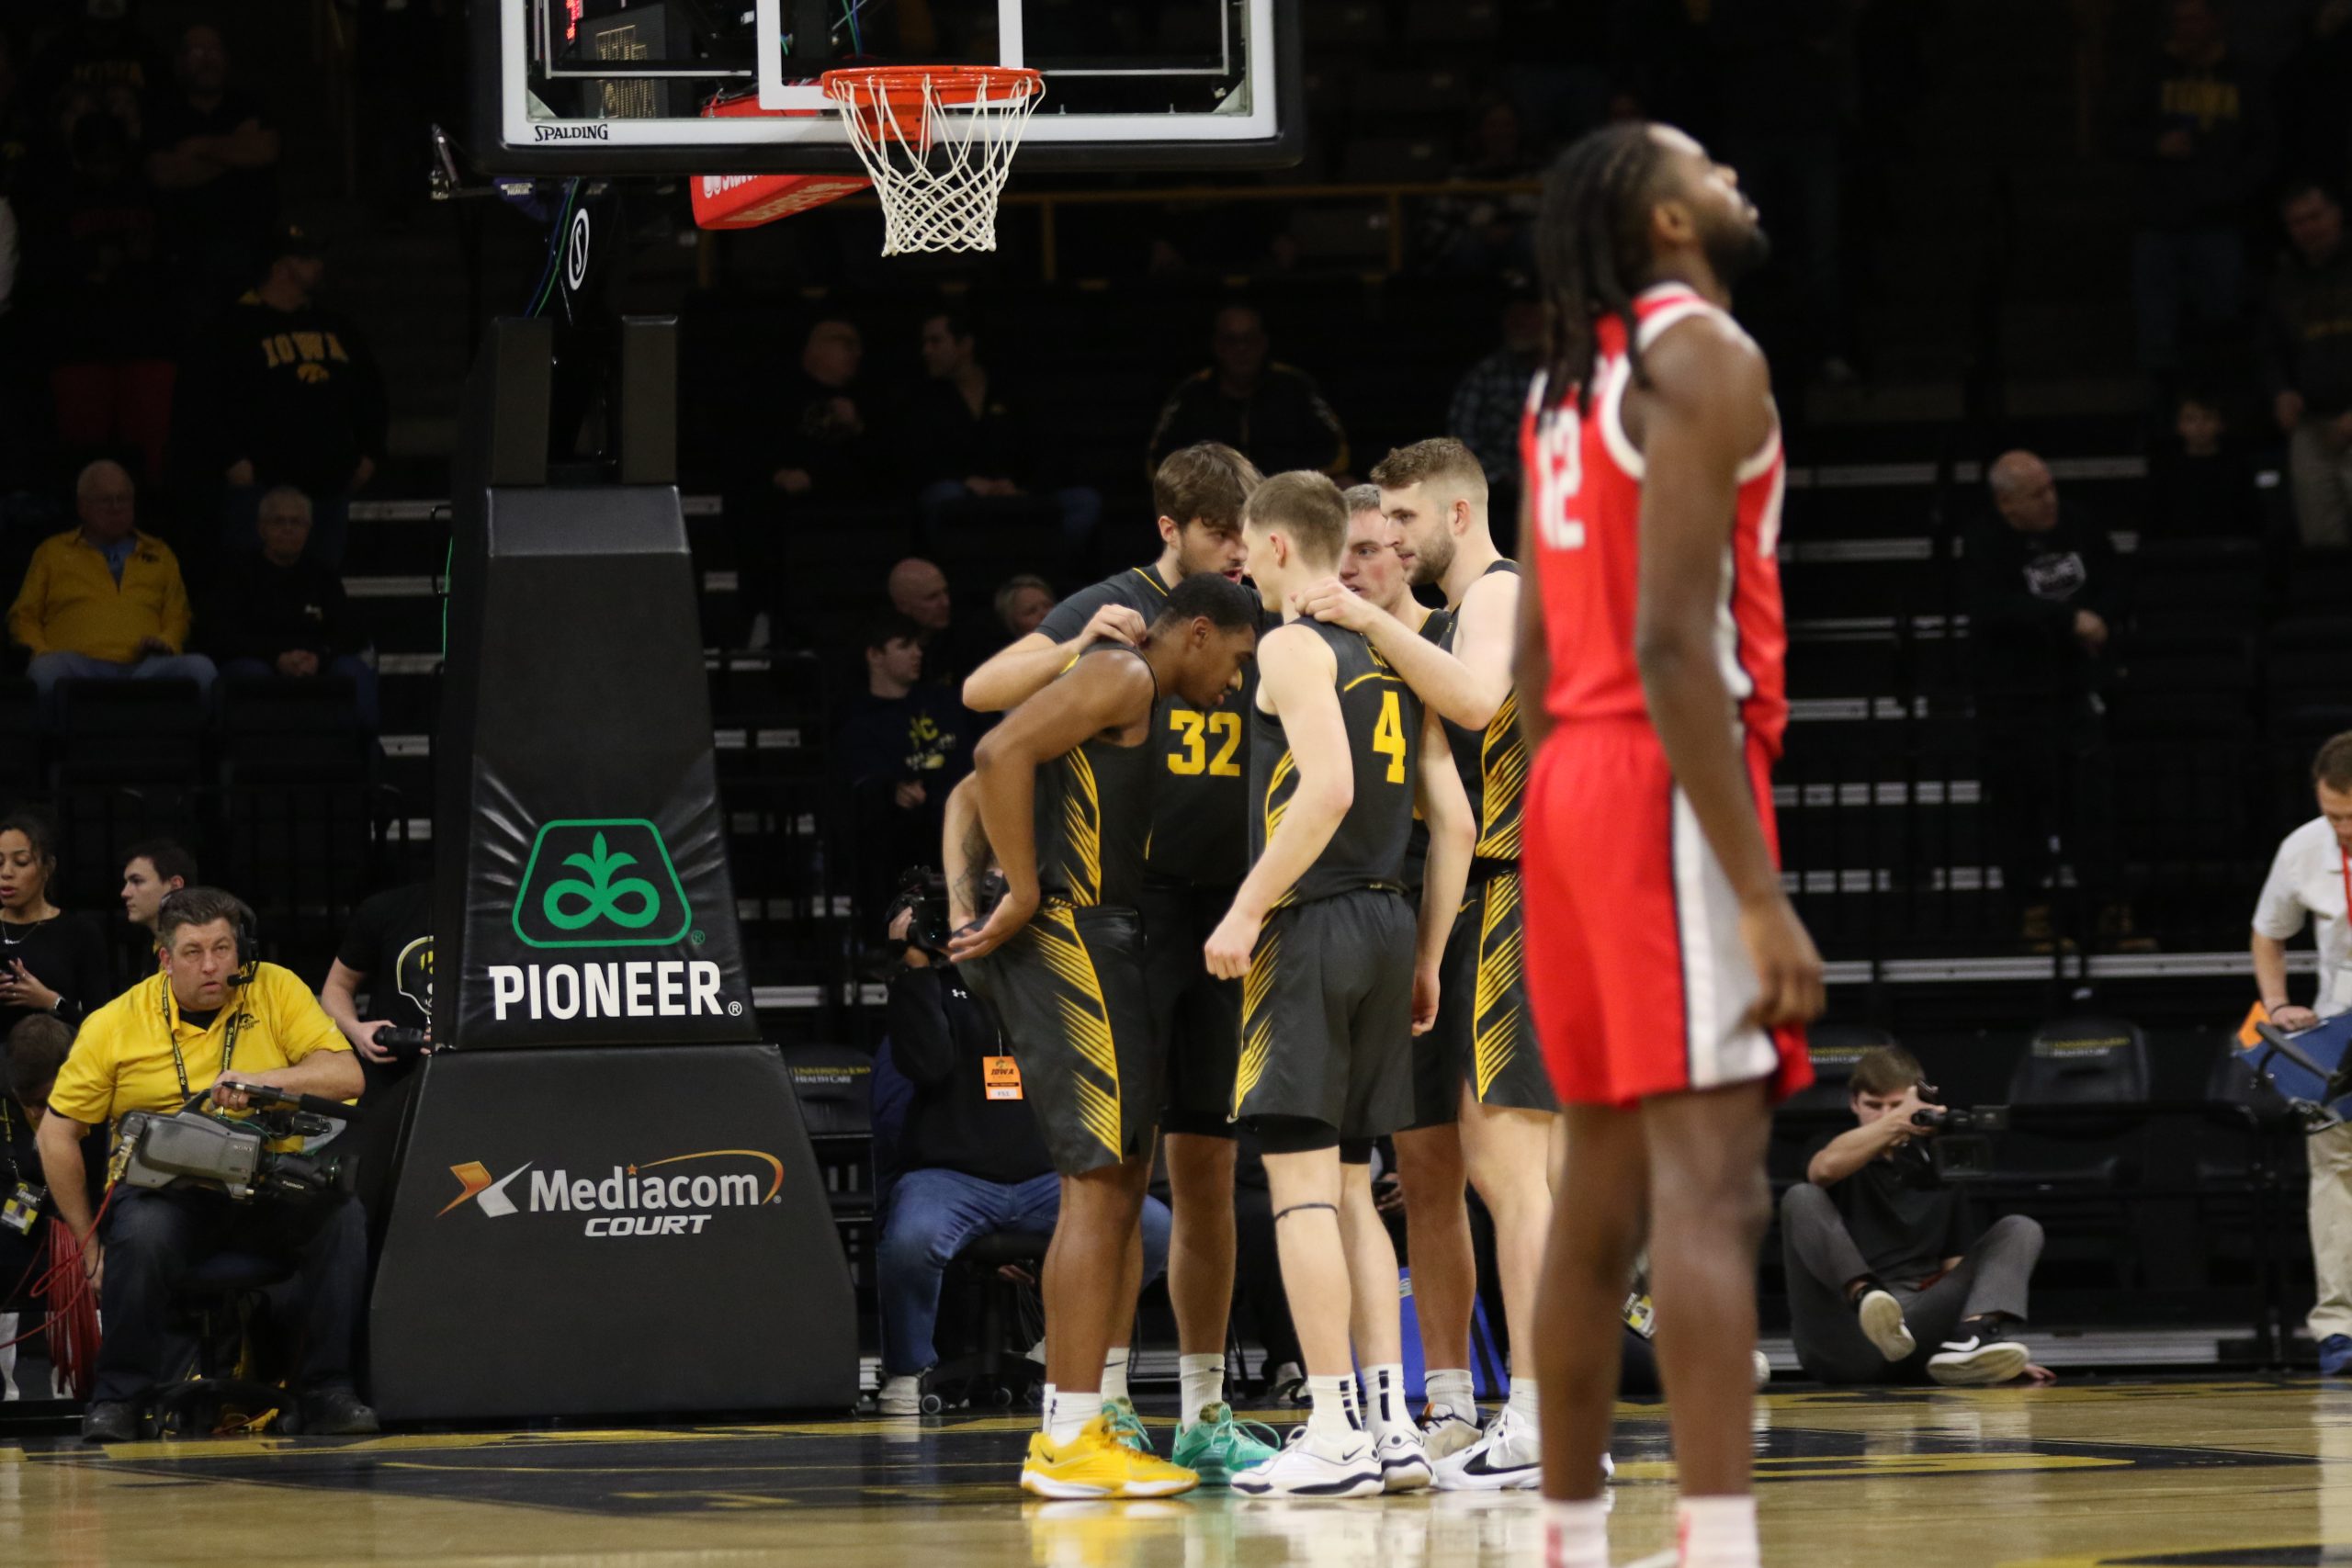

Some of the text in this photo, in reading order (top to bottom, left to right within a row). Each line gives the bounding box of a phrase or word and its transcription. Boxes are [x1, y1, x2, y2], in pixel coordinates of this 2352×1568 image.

[535, 124, 608, 141] SPALDING
[261, 331, 349, 367] IOWA
[1168, 708, 1241, 777] 32
[1373, 690, 1406, 784] 4
[489, 961, 724, 1021] PIONEER
[530, 1165, 759, 1213] Mediacom
[584, 1214, 711, 1237] COURT
